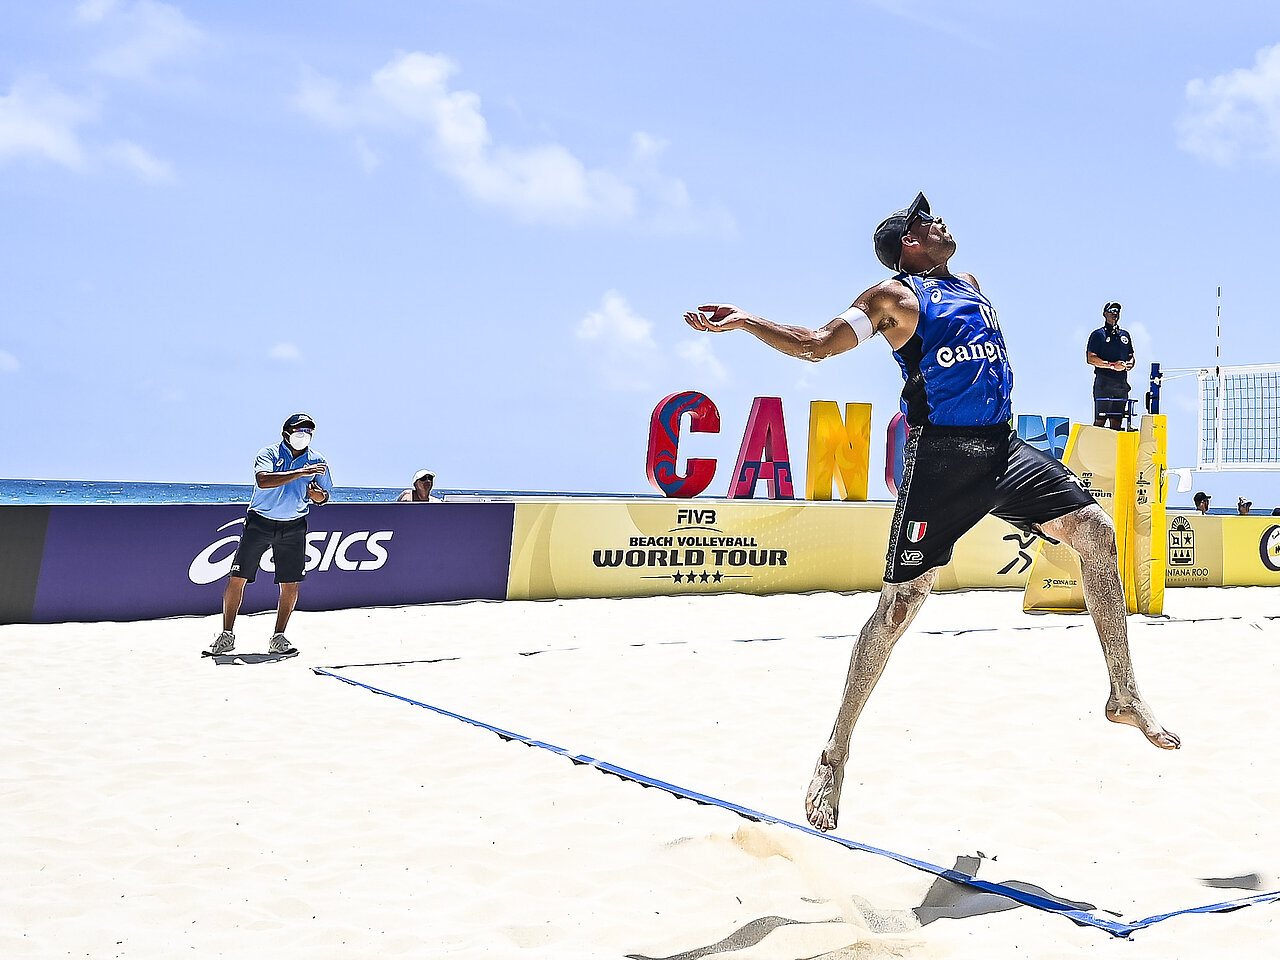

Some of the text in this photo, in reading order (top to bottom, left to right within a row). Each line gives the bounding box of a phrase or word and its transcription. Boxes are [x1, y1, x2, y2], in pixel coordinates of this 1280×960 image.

[677, 509, 717, 525] FIVB
[629, 536, 758, 547] BEACH VOLLEYBALL
[593, 548, 788, 568] WORLD TOUR
[1165, 568, 1209, 577] INTANA ROO
